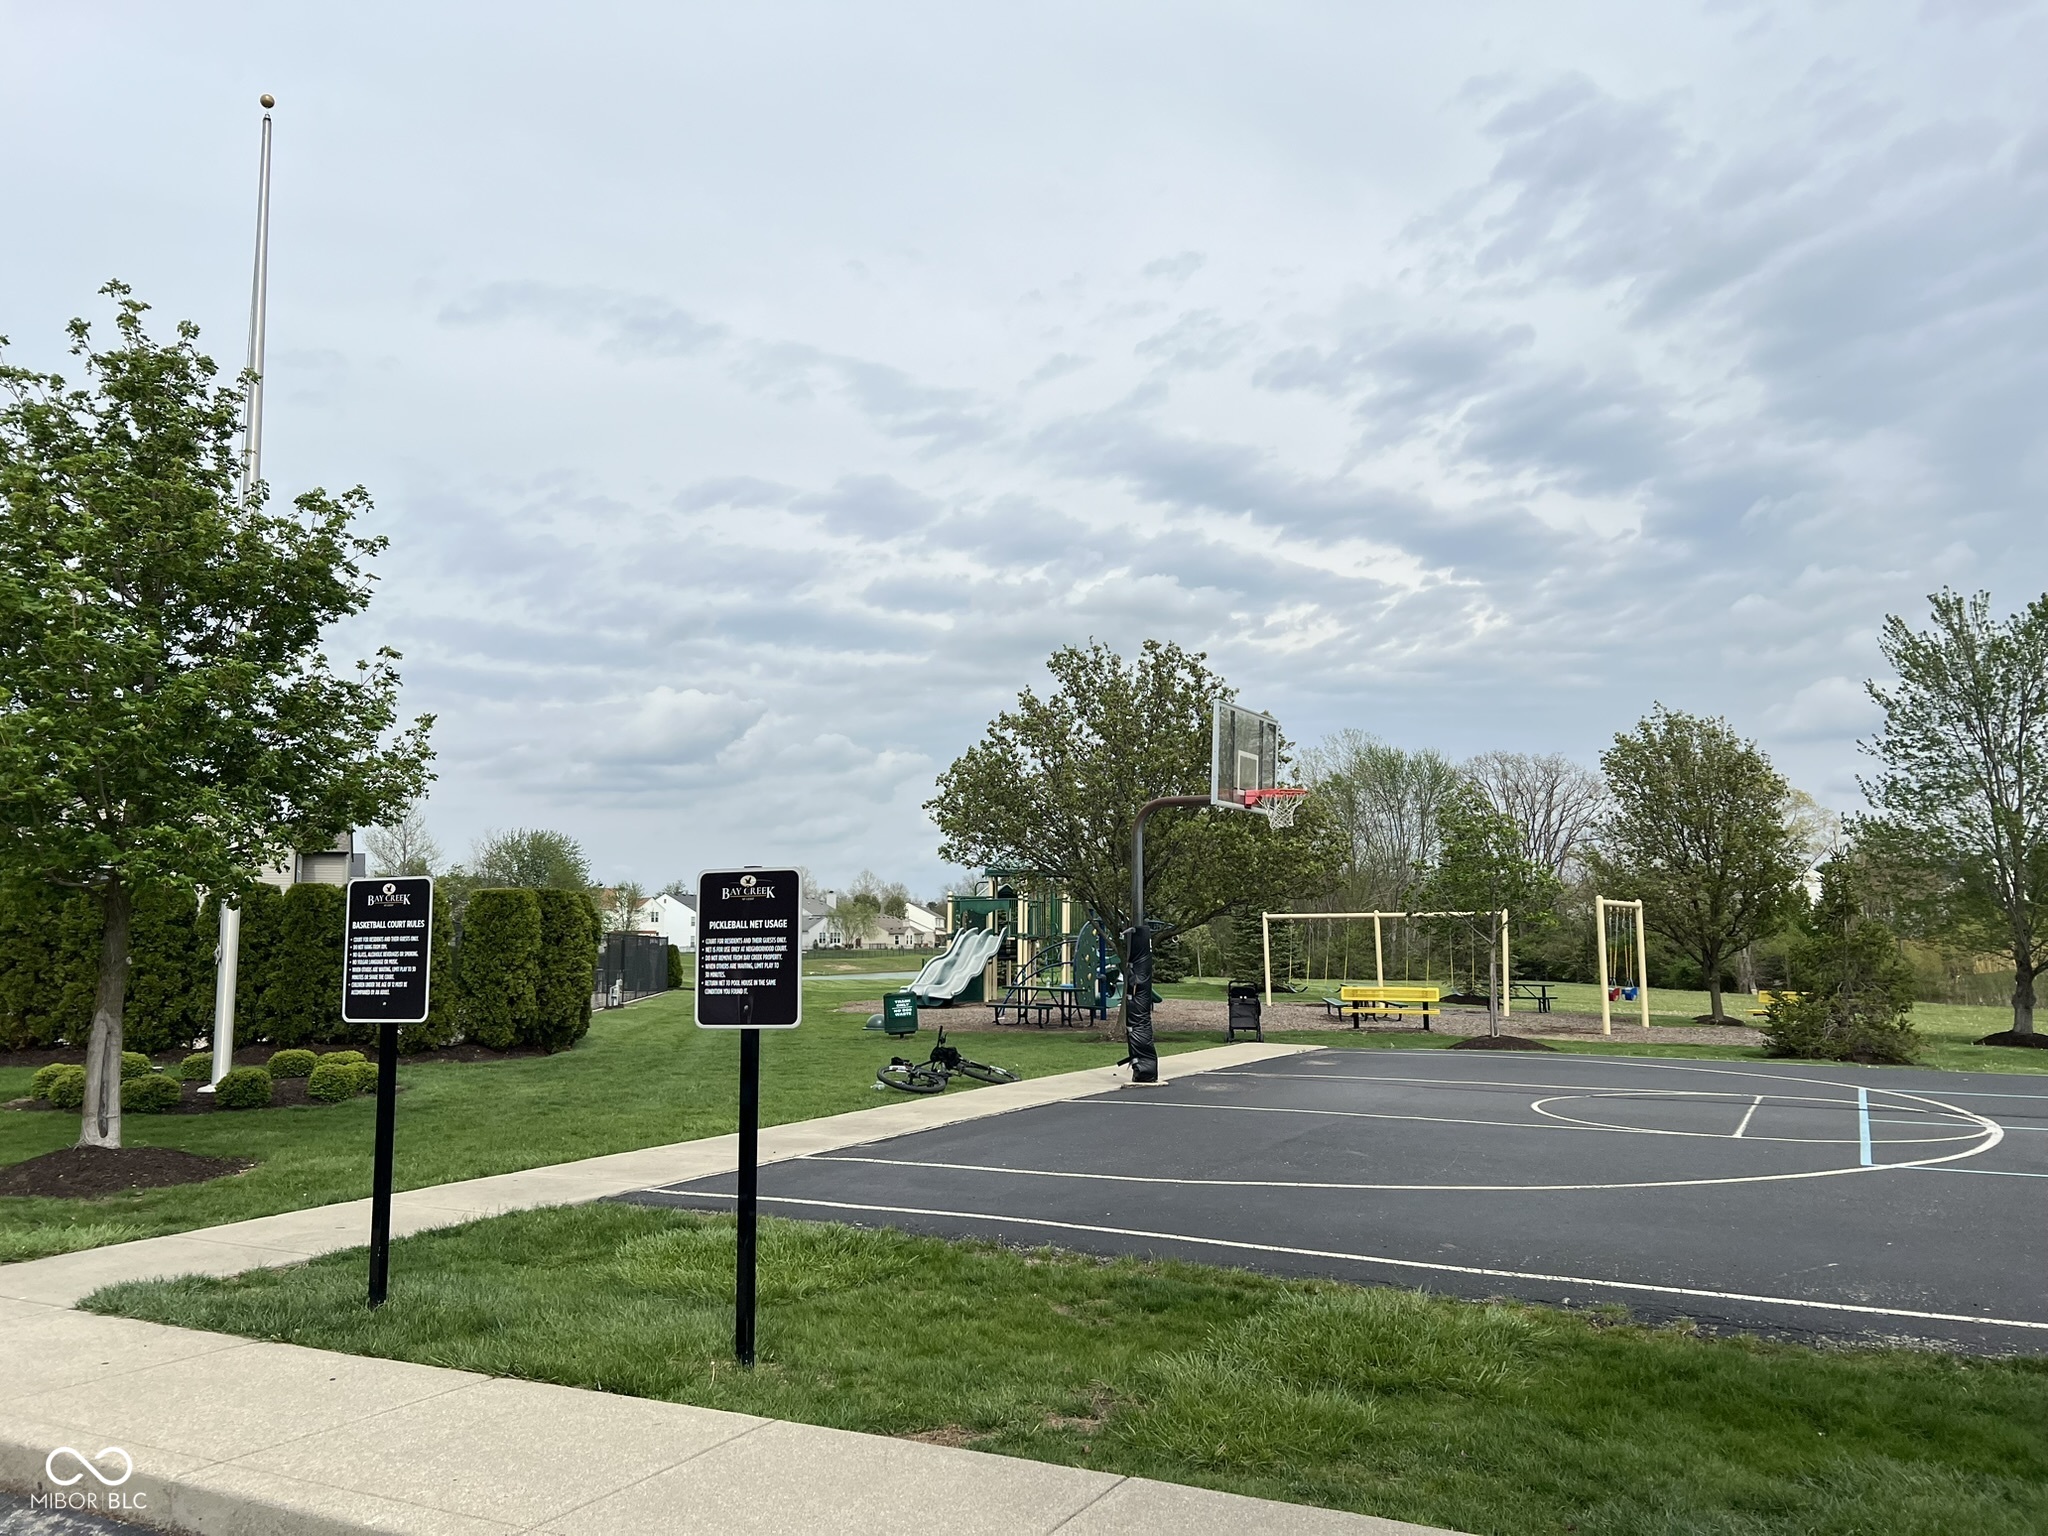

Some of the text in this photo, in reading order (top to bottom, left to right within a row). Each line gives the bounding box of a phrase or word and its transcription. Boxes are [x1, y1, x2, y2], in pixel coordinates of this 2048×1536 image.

[722, 886, 775, 899] BAY CREEK
[368, 894, 410, 906] BAY CREEK
[352, 921, 386, 929] BASKETBALL
[709, 919, 787, 929] PICKLEBALL NET USAGE
